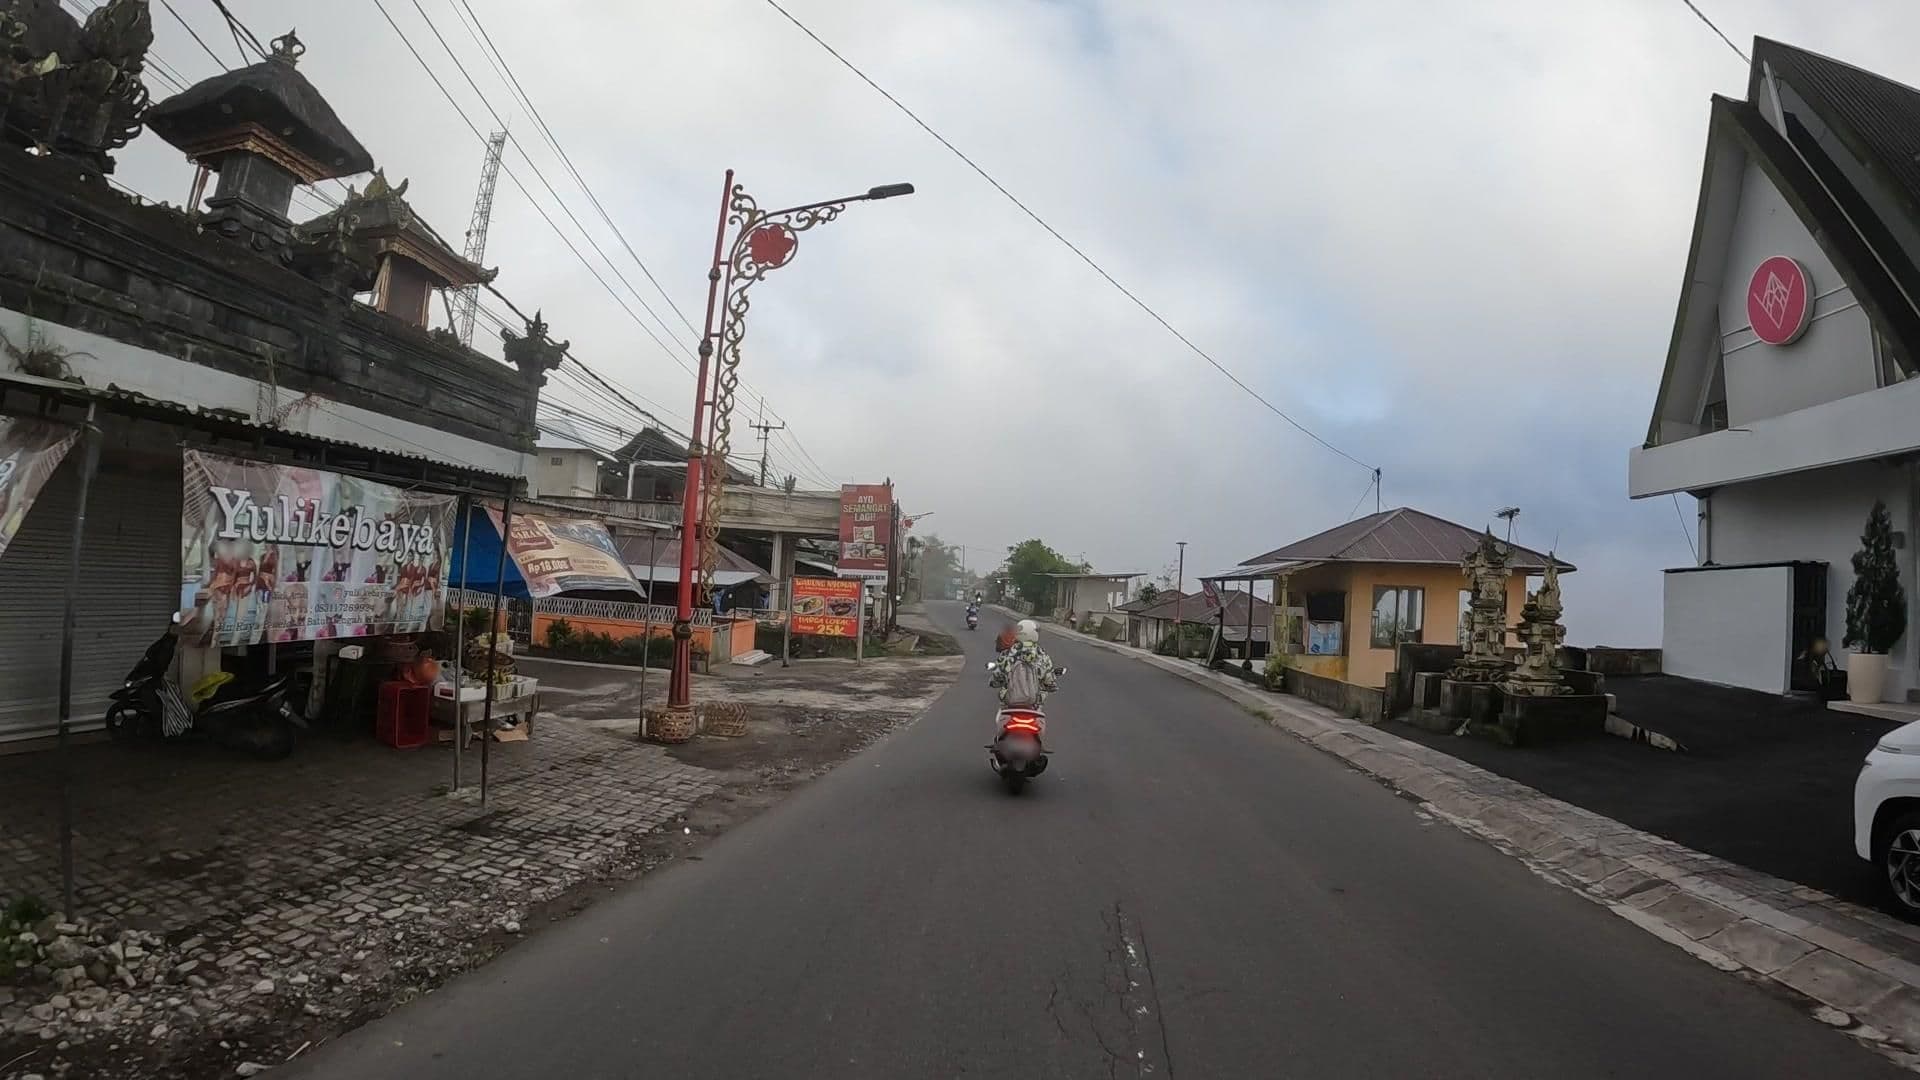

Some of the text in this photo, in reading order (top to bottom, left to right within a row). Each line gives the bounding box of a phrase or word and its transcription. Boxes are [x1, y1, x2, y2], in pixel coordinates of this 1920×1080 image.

[858, 495, 873, 504] AYO
[843, 504, 888, 513] SEMANGAT
[210, 486, 434, 563] Yulikebaya
